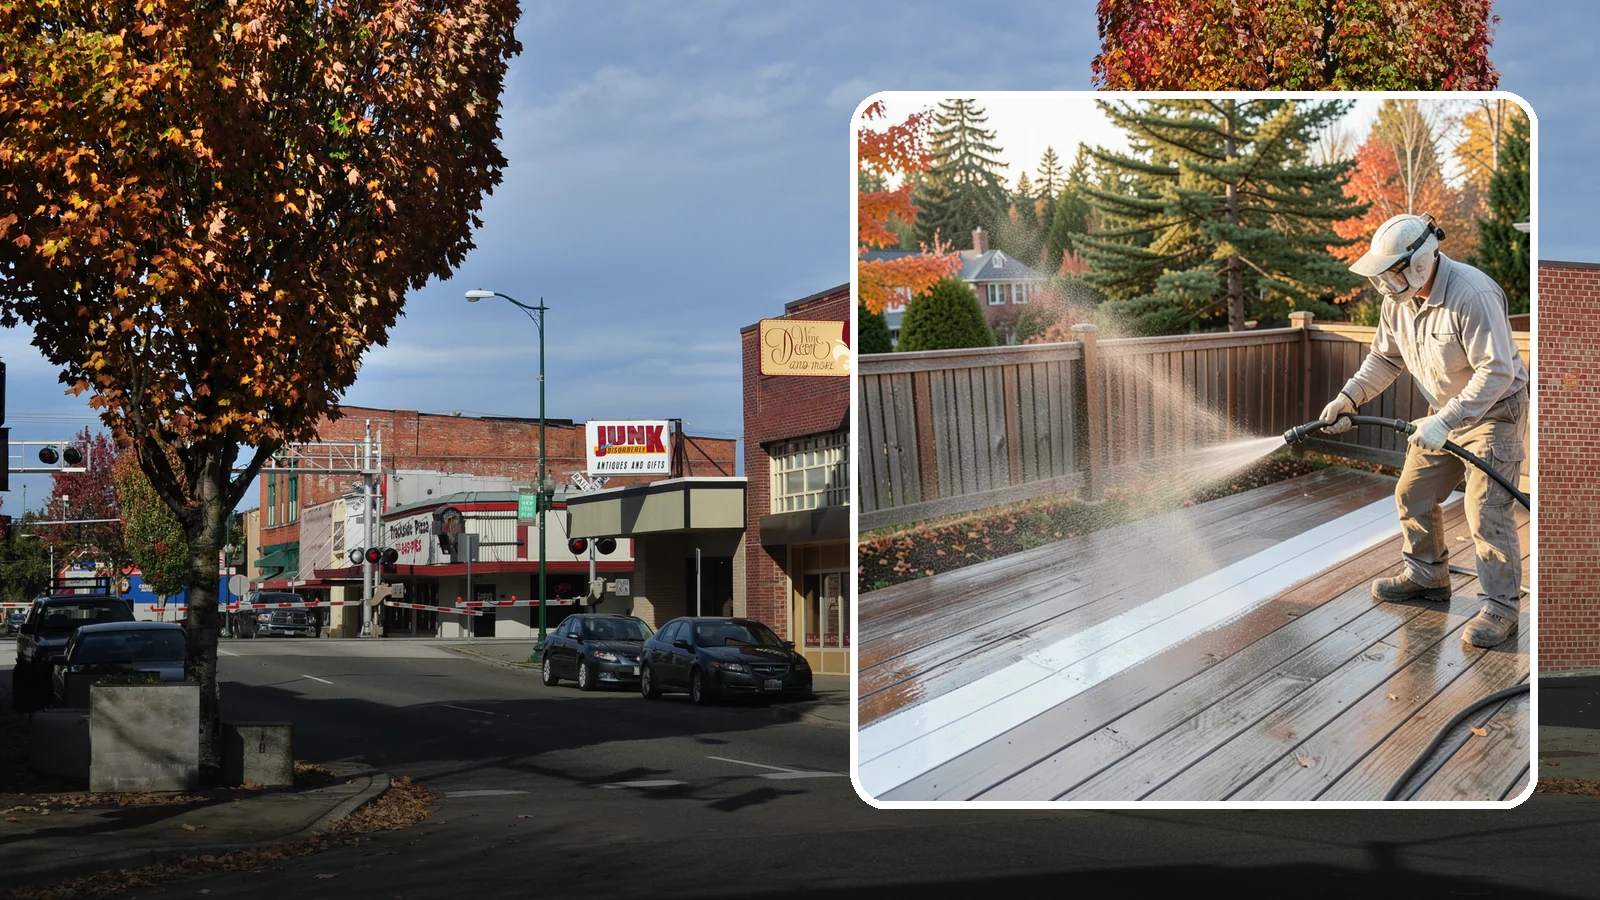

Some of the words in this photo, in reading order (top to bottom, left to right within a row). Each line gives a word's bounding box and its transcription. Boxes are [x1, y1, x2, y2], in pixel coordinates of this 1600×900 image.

[596, 425, 665, 457] JUNK
[607, 446, 646, 454] DISORDERLY
[597, 462, 628, 470] ANTIQUES
[631, 461, 643, 469] AND
[647, 461, 665, 469] GIFTS
[390, 521, 413, 539] Trackside
[415, 519, 429, 535] Pizza
